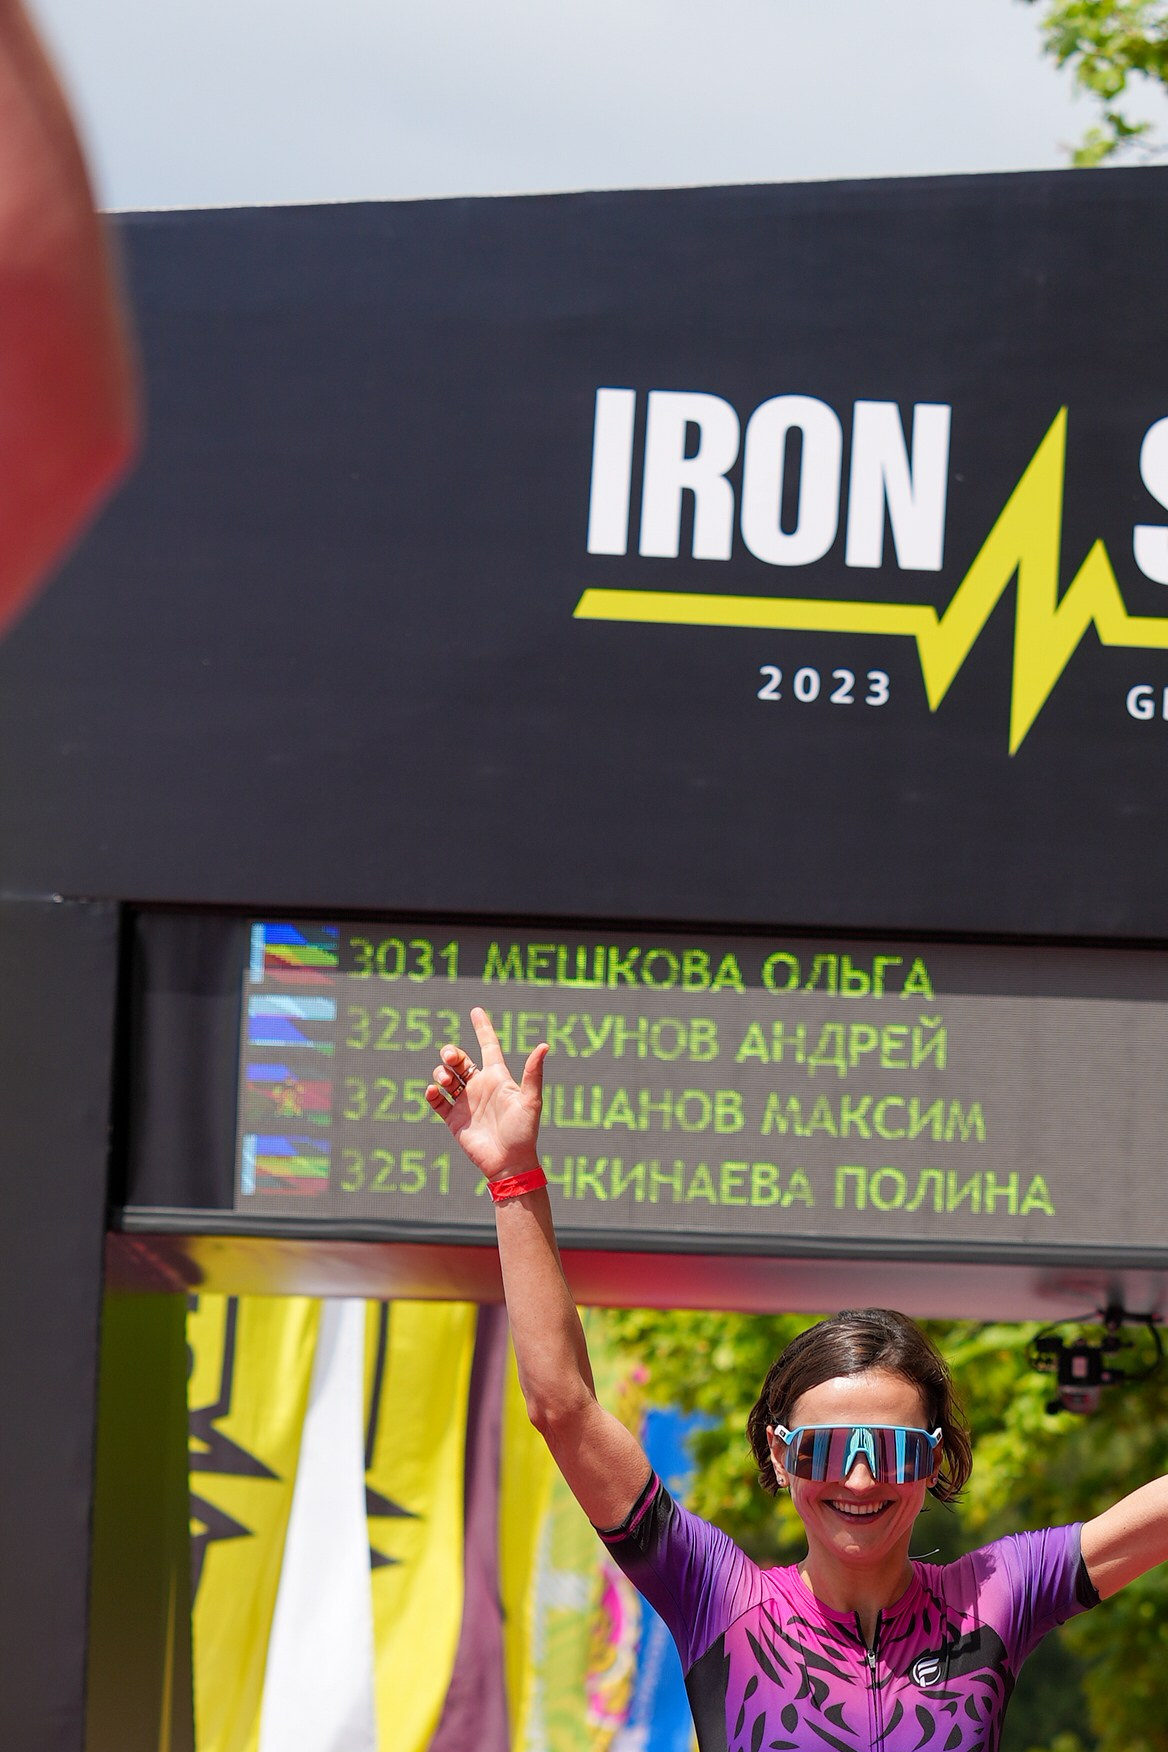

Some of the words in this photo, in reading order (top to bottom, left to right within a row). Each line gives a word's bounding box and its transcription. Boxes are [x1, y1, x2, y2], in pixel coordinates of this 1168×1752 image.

[586, 387, 951, 571] IRON
[757, 664, 892, 707] 2023
[347, 936, 459, 983] 3031
[482, 940, 746, 994] МЕШКОВА
[761, 951, 936, 1001] ОЛЬГА
[346, 1006, 461, 1052] 3253
[735, 1014, 948, 1078] АНДРЕЙ
[343, 1078, 446, 1124] 325
[760, 1090, 987, 1143] МАКСИМ
[340, 1147, 451, 1196] 3251
[834, 1165, 1056, 1216] ПОЛИНА
